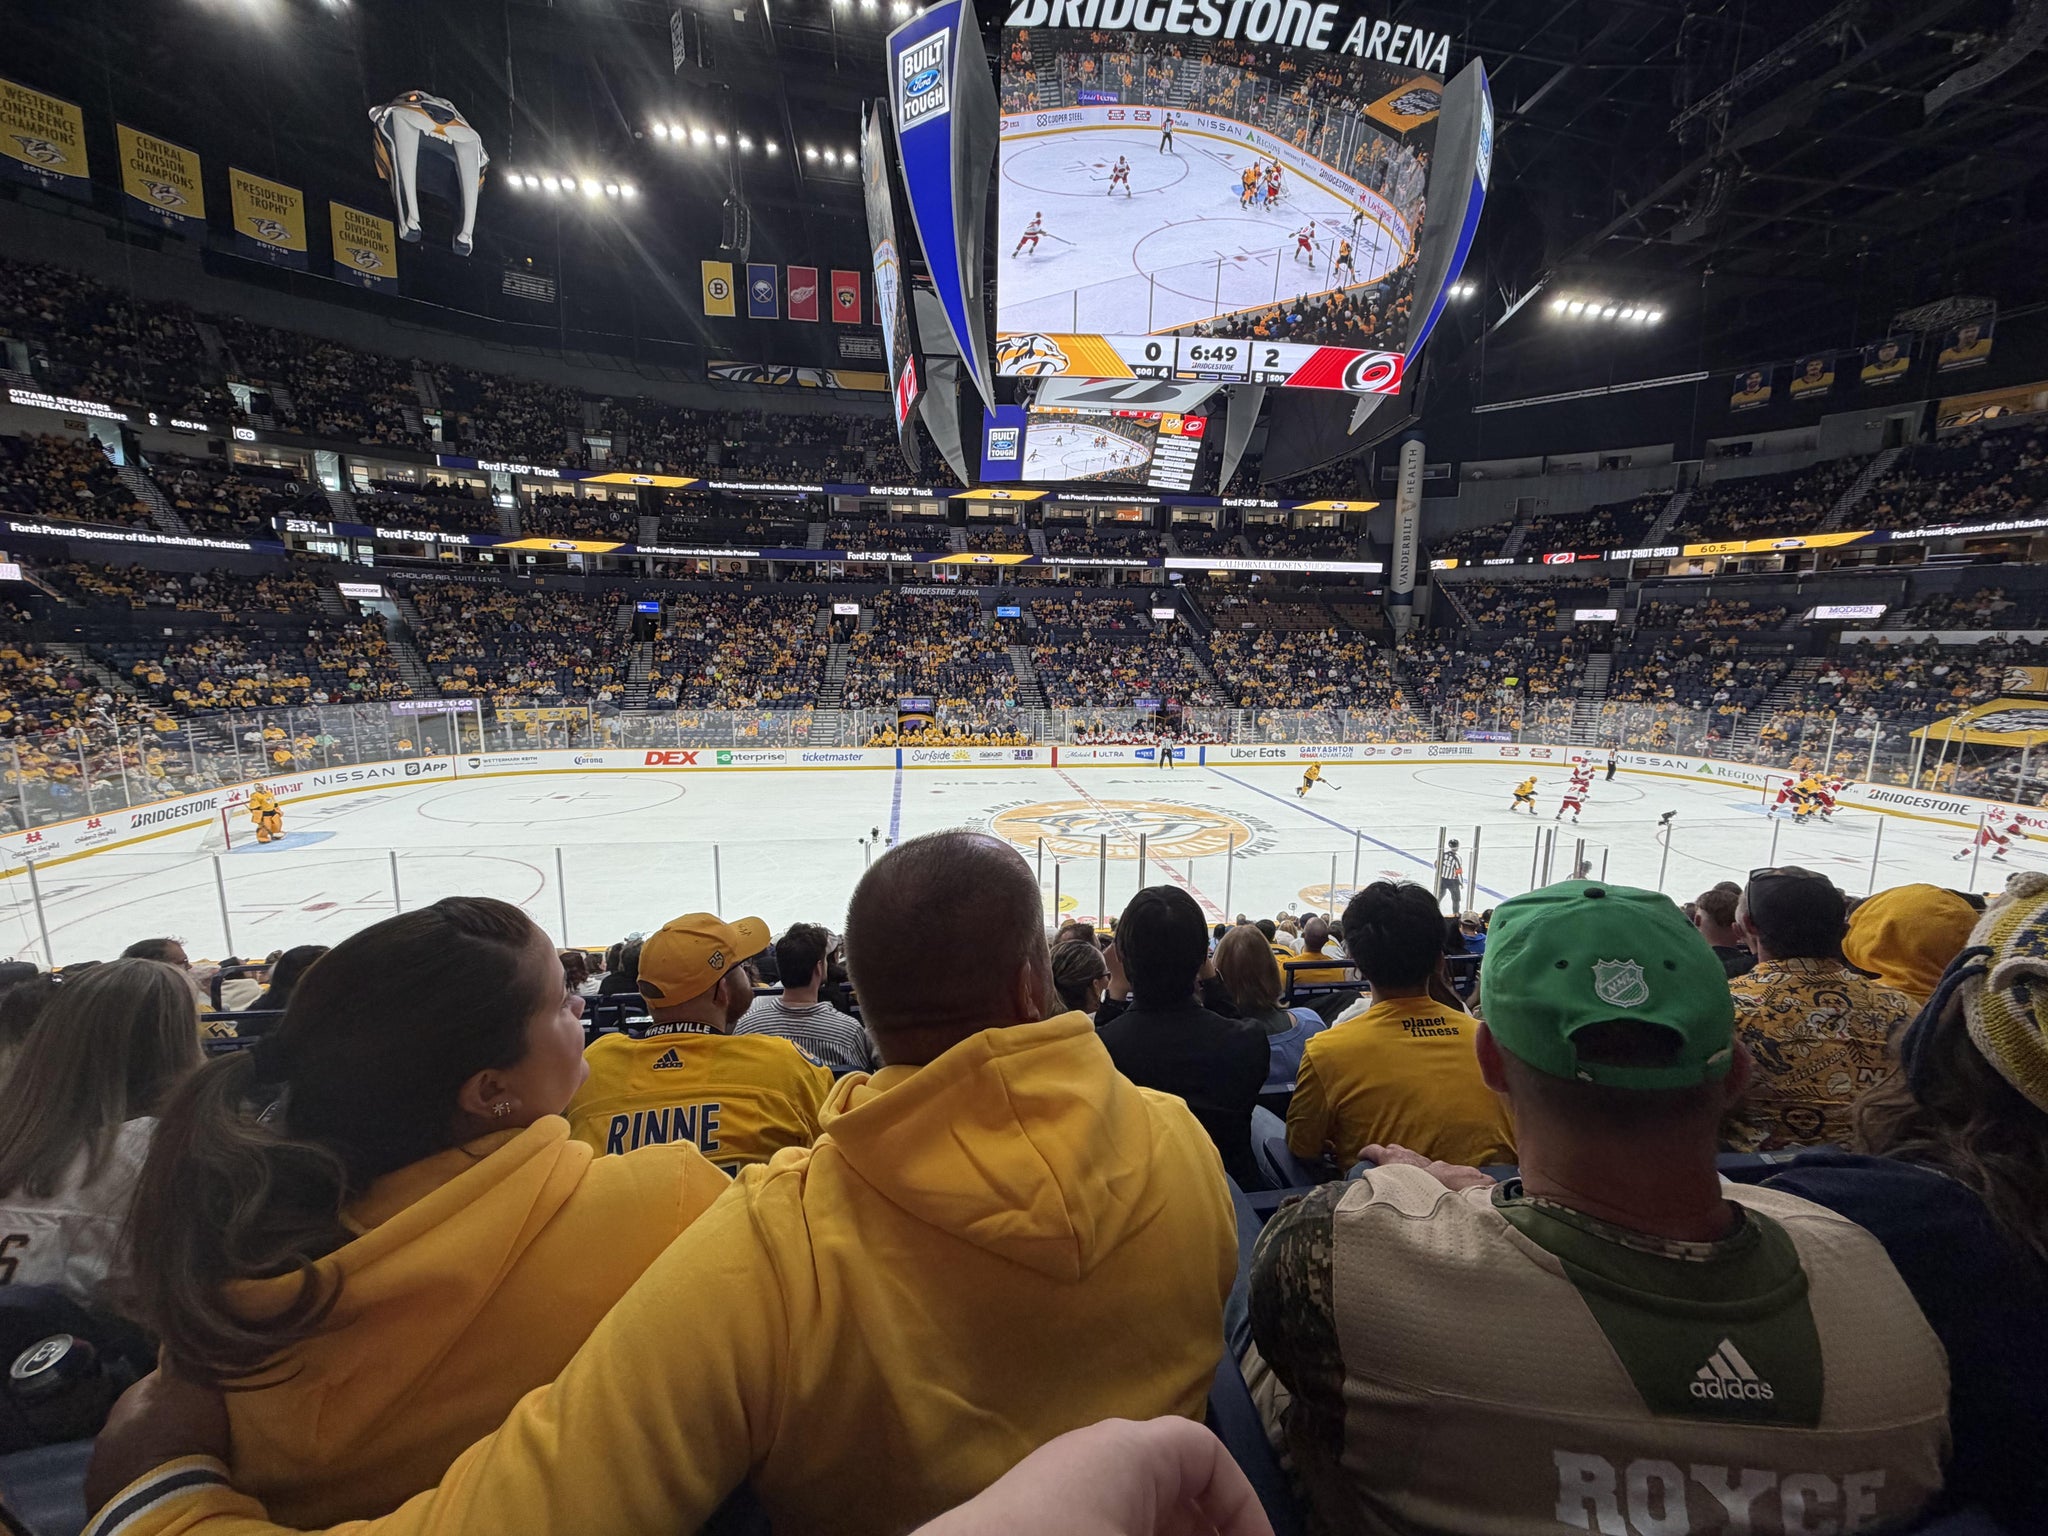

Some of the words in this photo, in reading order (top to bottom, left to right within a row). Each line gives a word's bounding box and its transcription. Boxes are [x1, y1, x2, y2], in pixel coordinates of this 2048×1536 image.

[1003, 0, 1339, 51] BRIDGESTONE
[1340, 16, 1450, 74] ARENA
[903, 39, 944, 79] BUILT
[4, 86, 64, 117] WESTERN
[904, 87, 944, 120] TOUGH
[0, 98, 77, 135] ONFERENCE
[1047, 113, 1067, 124] COOPER
[1068, 112, 1084, 122] STEEL
[0, 111, 76, 147] CHAMPIONS
[1197, 117, 1242, 137] NISSAN
[136, 136, 183, 163] CENTRAL
[136, 150, 185, 176] DIVISION
[130, 158, 194, 190] CHAMPIONS
[1318, 168, 1356, 196] BRIDGESTONE
[250, 195, 287, 216] TROPHY
[344, 210, 381, 230] CENTRAL
[344, 223, 382, 242] DIVISION
[339, 231, 389, 254] CHAMPIONS
[1145, 342, 1161, 362] 0
[1190, 345, 1238, 362] 6:49
[1264, 349, 1280, 368] 2
[1158, 368, 1169, 378] 4
[1191, 362, 1234, 371] BRIDGESTONE
[1255, 373, 1263, 383] 5
[8, 389, 55, 403] OTTAWA
[56, 397, 111, 412] SENATORS
[9, 396, 69, 412] MONTREAL
[69, 406, 128, 421] CANADIENS
[171, 419, 191, 429] 6:00
[193, 423, 208, 432] PM
[238, 429, 255, 441] CC
[991, 431, 1015, 441] BUILT
[991, 449, 1016, 457] TOUGH
[478, 460, 500, 471] Ford
[533, 467, 560, 478] Truck
[1407, 448, 1417, 494] HEALTH
[387, 474, 416, 484] WESLEY
[739, 483, 759, 491] Sponsor
[870, 487, 887, 495] Ford
[912, 488, 933, 497] Truck
[1260, 500, 1278, 508] Truck
[10, 522, 41, 534] Ford:
[42, 525, 77, 537] Proud
[78, 528, 125, 542] Sponsor
[126, 532, 138, 541] of
[138, 533, 155, 543] the
[156, 535, 203, 546] Nashville
[204, 538, 250, 550] Predators
[286, 522, 316, 533] 2:31
[1892, 529, 1915, 540] Ford:
[1916, 527, 1944, 538] Proud
[1945, 525, 1984, 537] Sponsor
[1984, 523, 1996, 532] of
[1997, 521, 2014, 531] the
[377, 528, 401, 539] Ford
[439, 532, 470, 545] Truck
[652, 547, 669, 555] Proud
[669, 548, 691, 556] Sponsor
[847, 552, 864, 560] Ford
[891, 553, 912, 561] Truck
[1399, 517, 1413, 586] VANDERBILT
[1611, 550, 1631, 560] LAST
[1632, 548, 1653, 559] SHOT
[1653, 546, 1679, 558] SPEED
[1700, 543, 1727, 553] 60.5
[1218, 561, 1267, 569] CALIFORNIA
[1483, 558, 1514, 566] FACEOFFS
[900, 587, 956, 596] BRIDGESTONE
[1828, 605, 1874, 614] MODERN
[574, 755, 603, 765] Corona
[644, 751, 700, 766] DEX
[720, 752, 786, 763] enterprise
[802, 752, 864, 762] ticketmaster
[911, 750, 950, 762] Surfside
[1230, 747, 1257, 758] Uber
[1259, 747, 1286, 758] Eats
[1616, 754, 1688, 770] NISSAN
[313, 767, 396, 787] NISSAN
[1867, 788, 1971, 816] BRIDGESTONE
[131, 797, 218, 829] BRIDGESTONE
[1607, 972, 1637, 996] NHL
[1401, 1016, 1446, 1031] planet
[1411, 1026, 1460, 1038] fitness
[653, 1061, 684, 1069] adidas
[606, 1103, 721, 1156] RINNE
[1689, 1376, 1774, 1400] adidas
[1552, 1449, 1887, 1536] ROYCE
